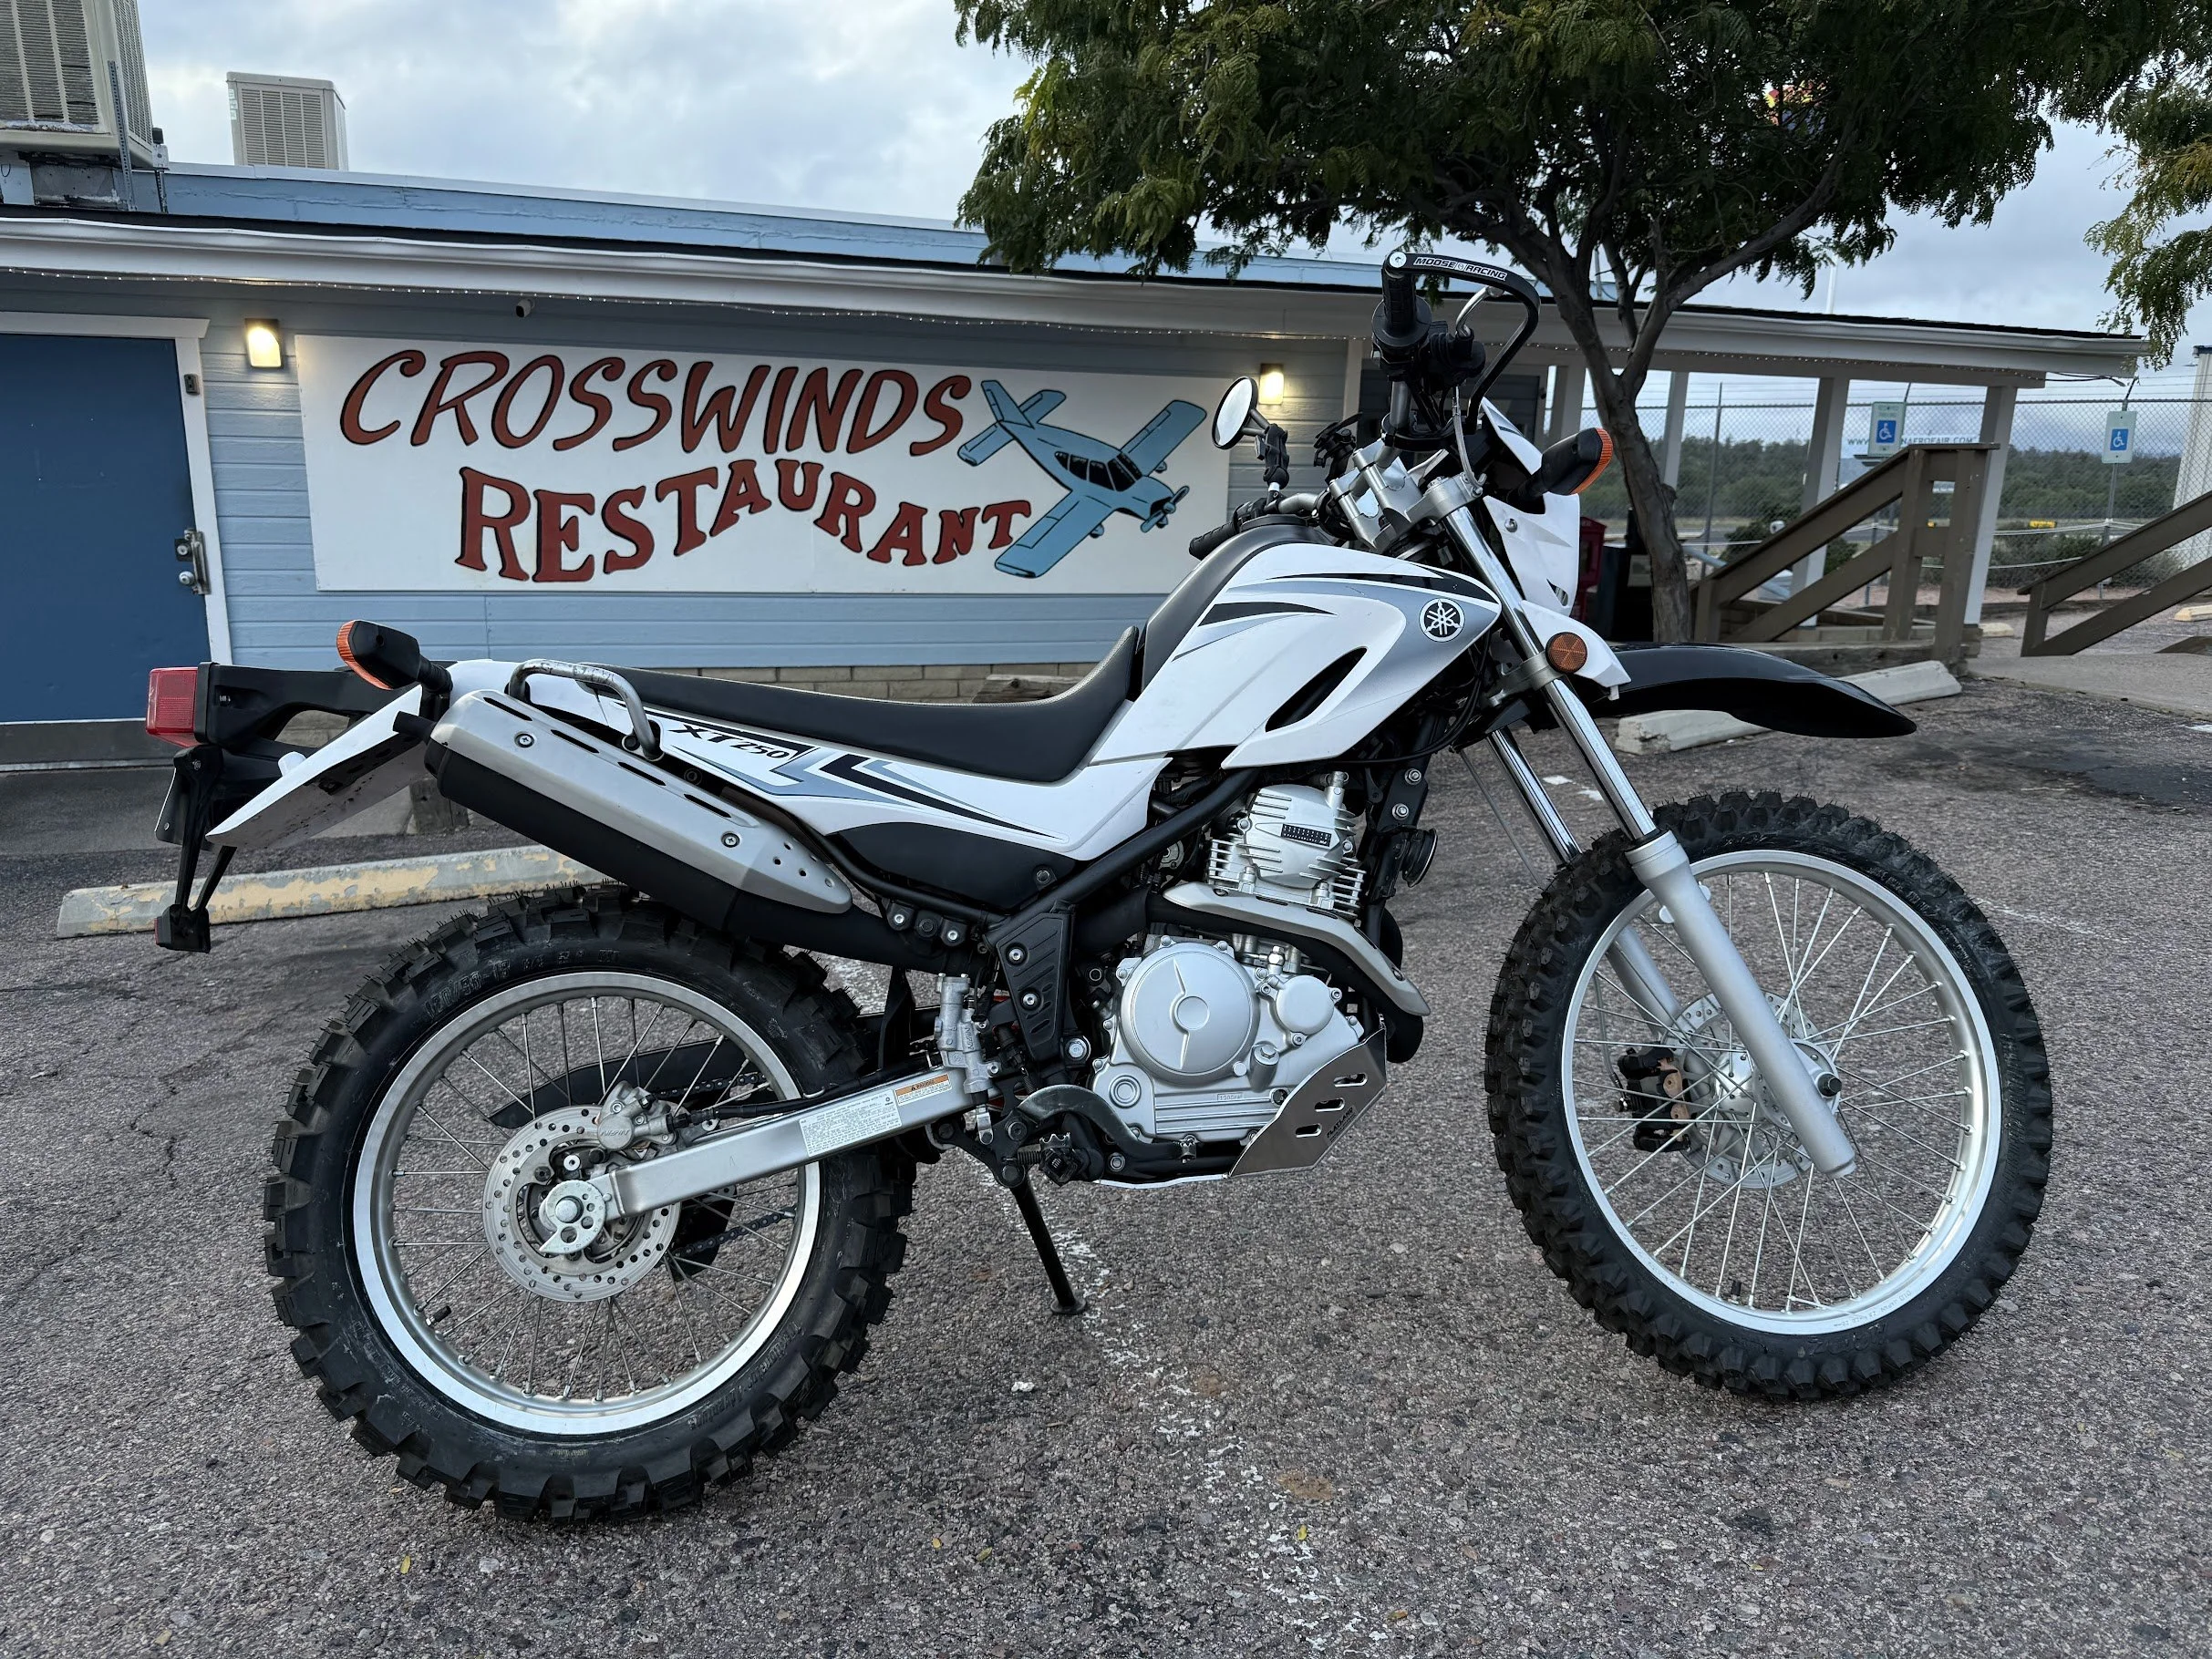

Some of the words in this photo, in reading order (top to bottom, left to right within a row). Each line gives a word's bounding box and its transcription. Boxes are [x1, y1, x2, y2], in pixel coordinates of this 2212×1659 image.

[1414, 257, 1456, 269] MOOSE
[1465, 265, 1506, 280] RACING
[340, 350, 971, 456] CROSSWINDS
[454, 459, 1031, 582] RESTAURANT
[667, 724, 791, 759] XT250
